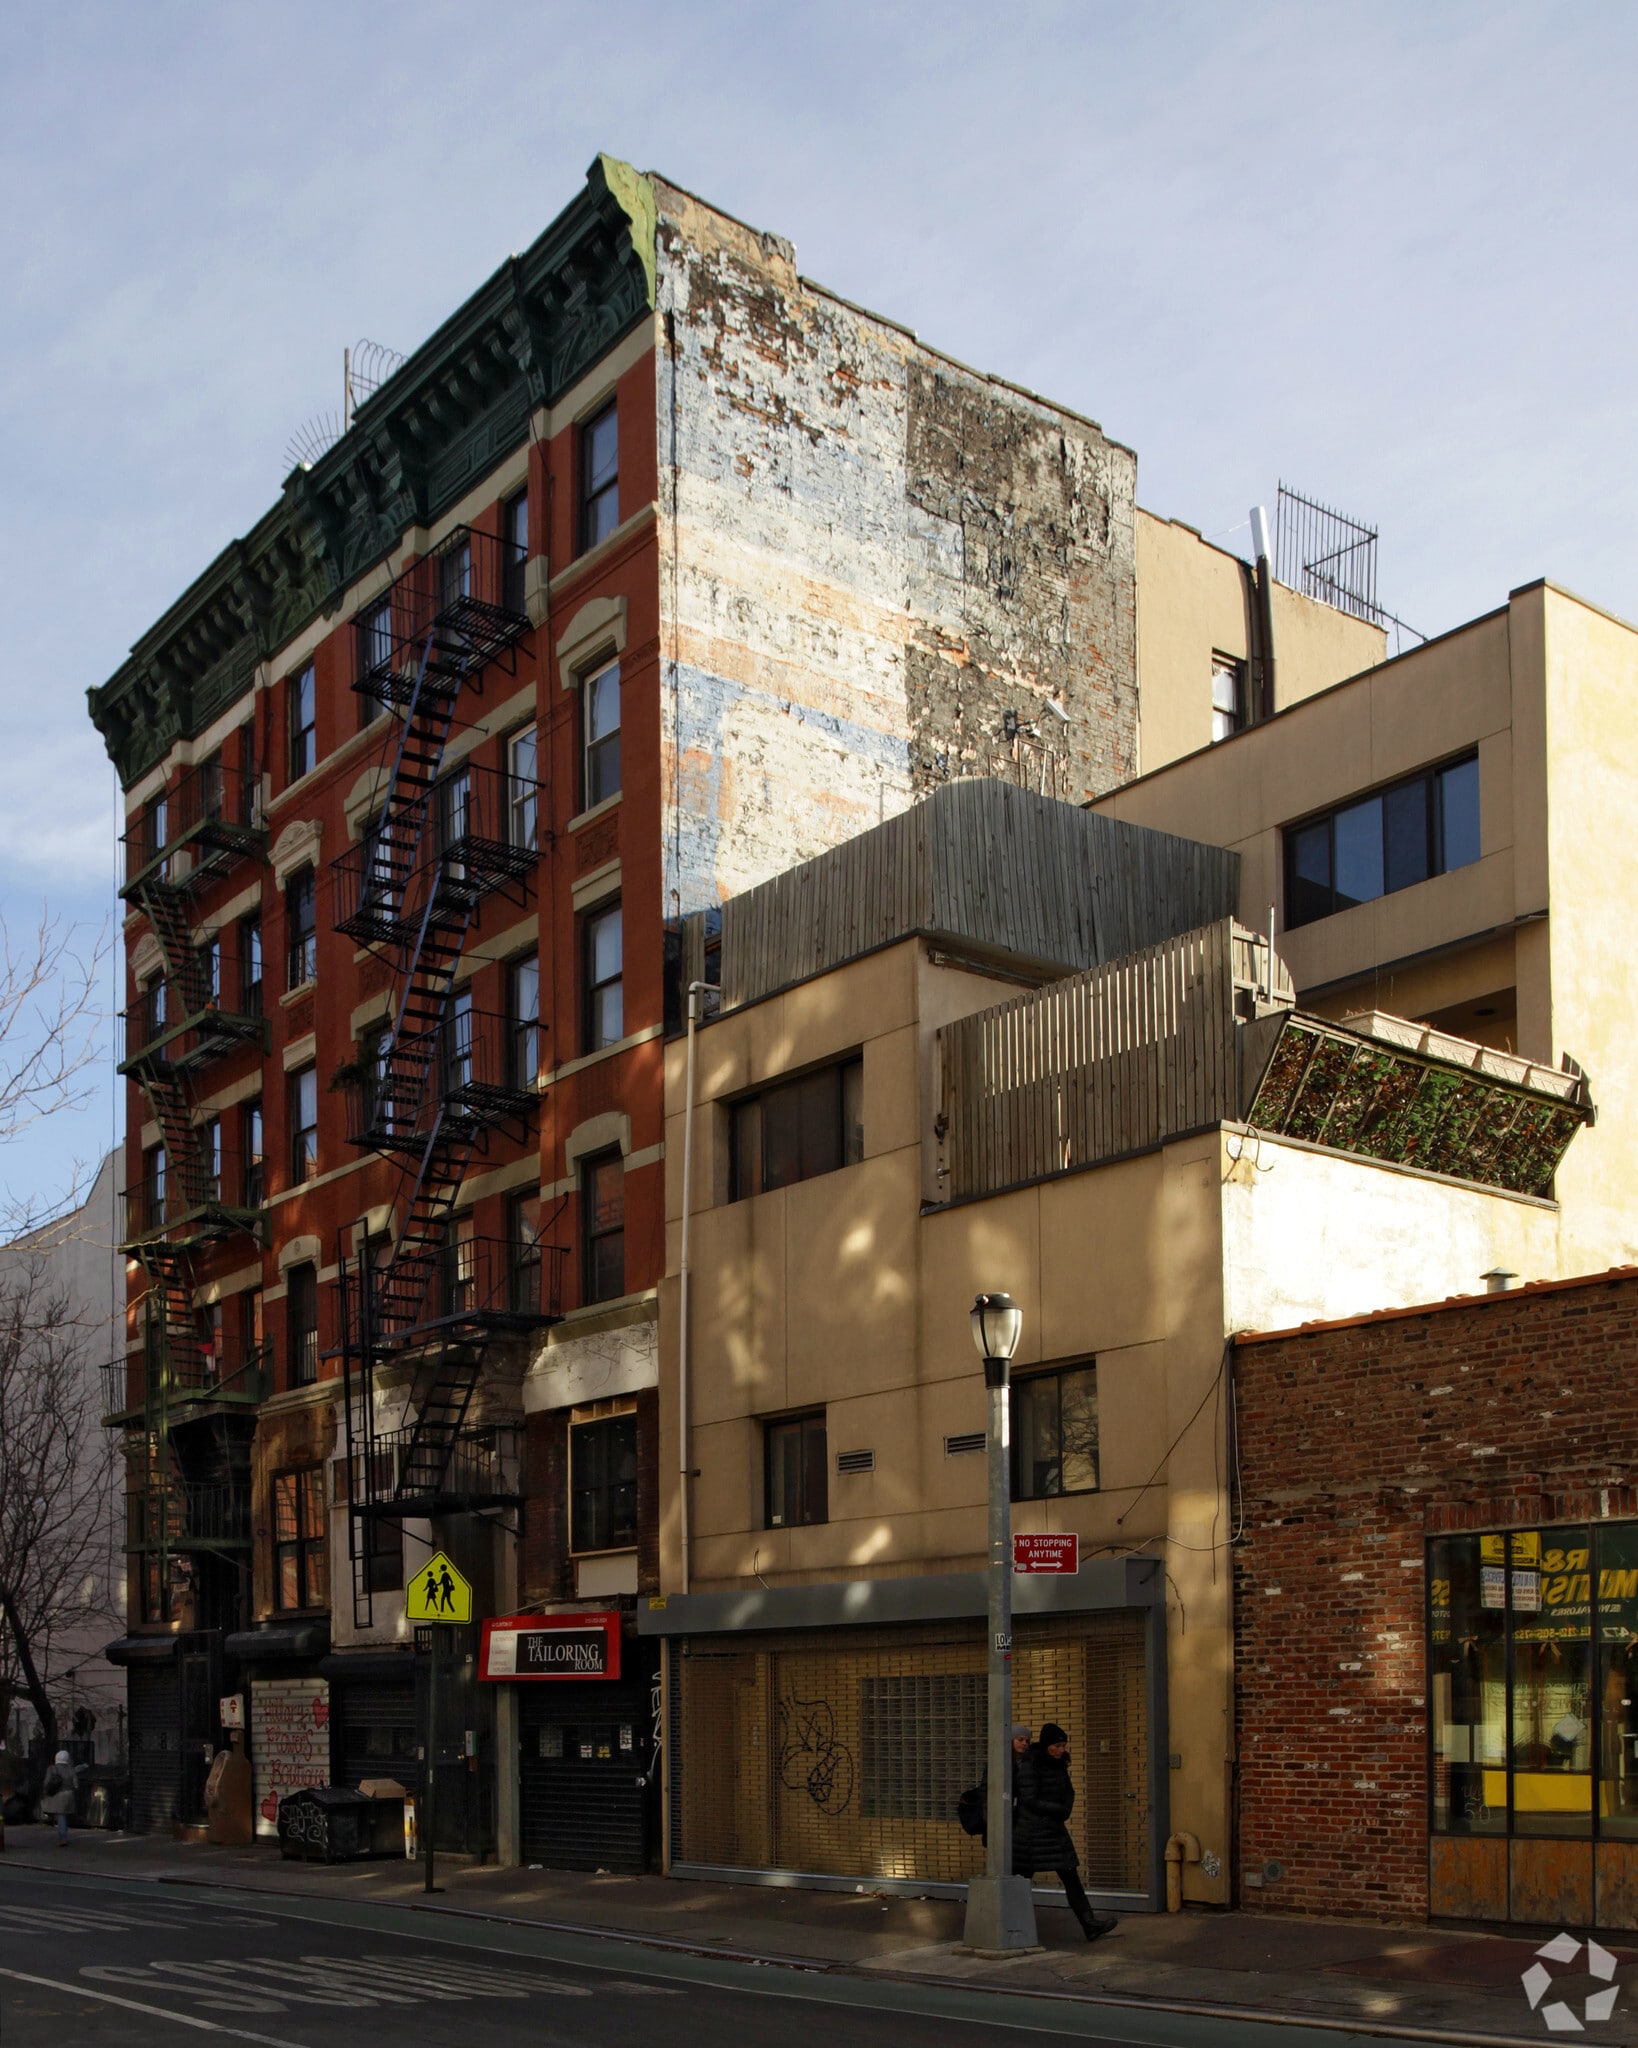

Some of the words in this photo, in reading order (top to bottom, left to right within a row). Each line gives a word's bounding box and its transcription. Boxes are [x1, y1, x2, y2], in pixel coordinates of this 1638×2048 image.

[1019, 1539, 1030, 1547] NO
[1034, 1539, 1072, 1547] STOPPING
[1028, 1549, 1063, 1558] ANYTIME
[527, 1636, 543, 1648] THE
[528, 1644, 599, 1662] TAILORING
[574, 1659, 603, 1671] ROOM
